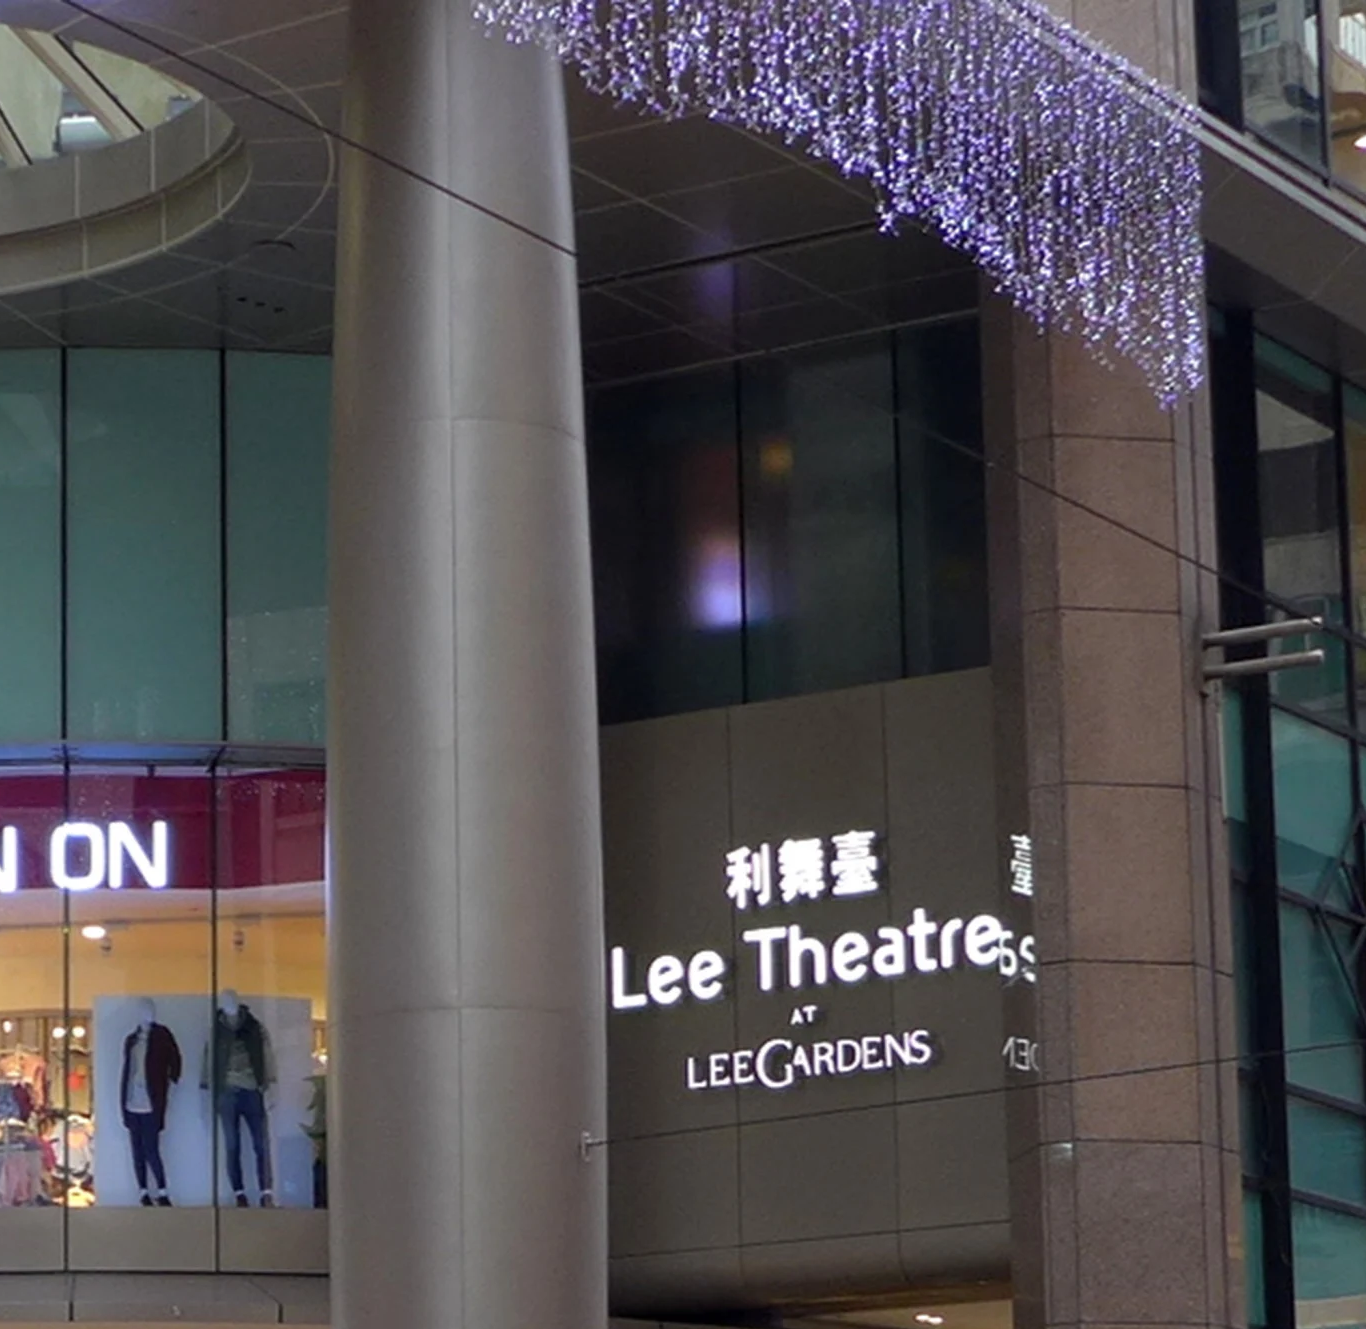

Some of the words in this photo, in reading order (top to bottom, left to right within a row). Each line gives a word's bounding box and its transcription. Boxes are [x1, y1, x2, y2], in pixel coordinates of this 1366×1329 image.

[50, 820, 169, 891] ON
[610, 946, 726, 1010] Lee
[742, 907, 1003, 992] Theatre
[790, 1005, 819, 1026] AT
